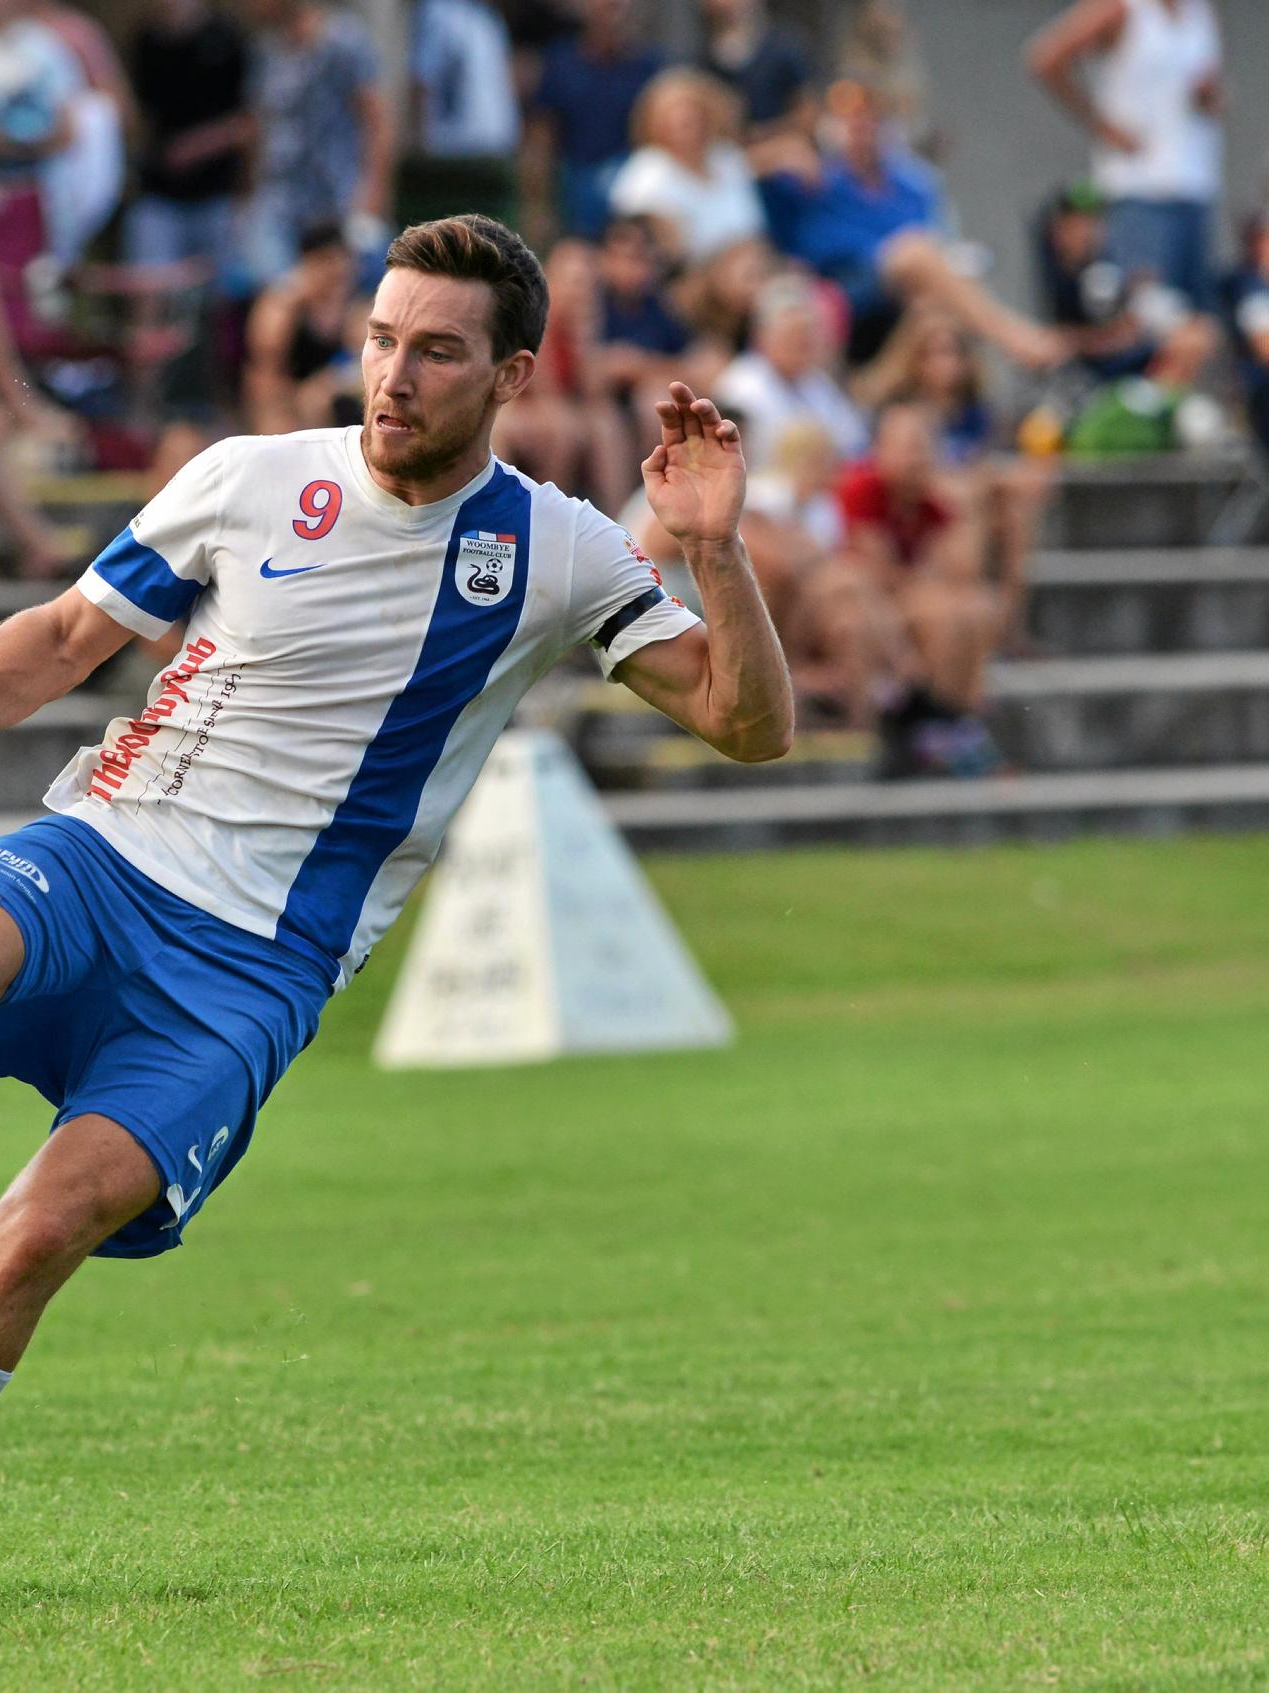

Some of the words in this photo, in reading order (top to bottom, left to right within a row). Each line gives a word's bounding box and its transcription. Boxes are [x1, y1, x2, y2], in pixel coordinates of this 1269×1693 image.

[292, 479, 343, 541] 9
[467, 541, 510, 551] WOOMBYE
[463, 548, 494, 557] FOOTBALL
